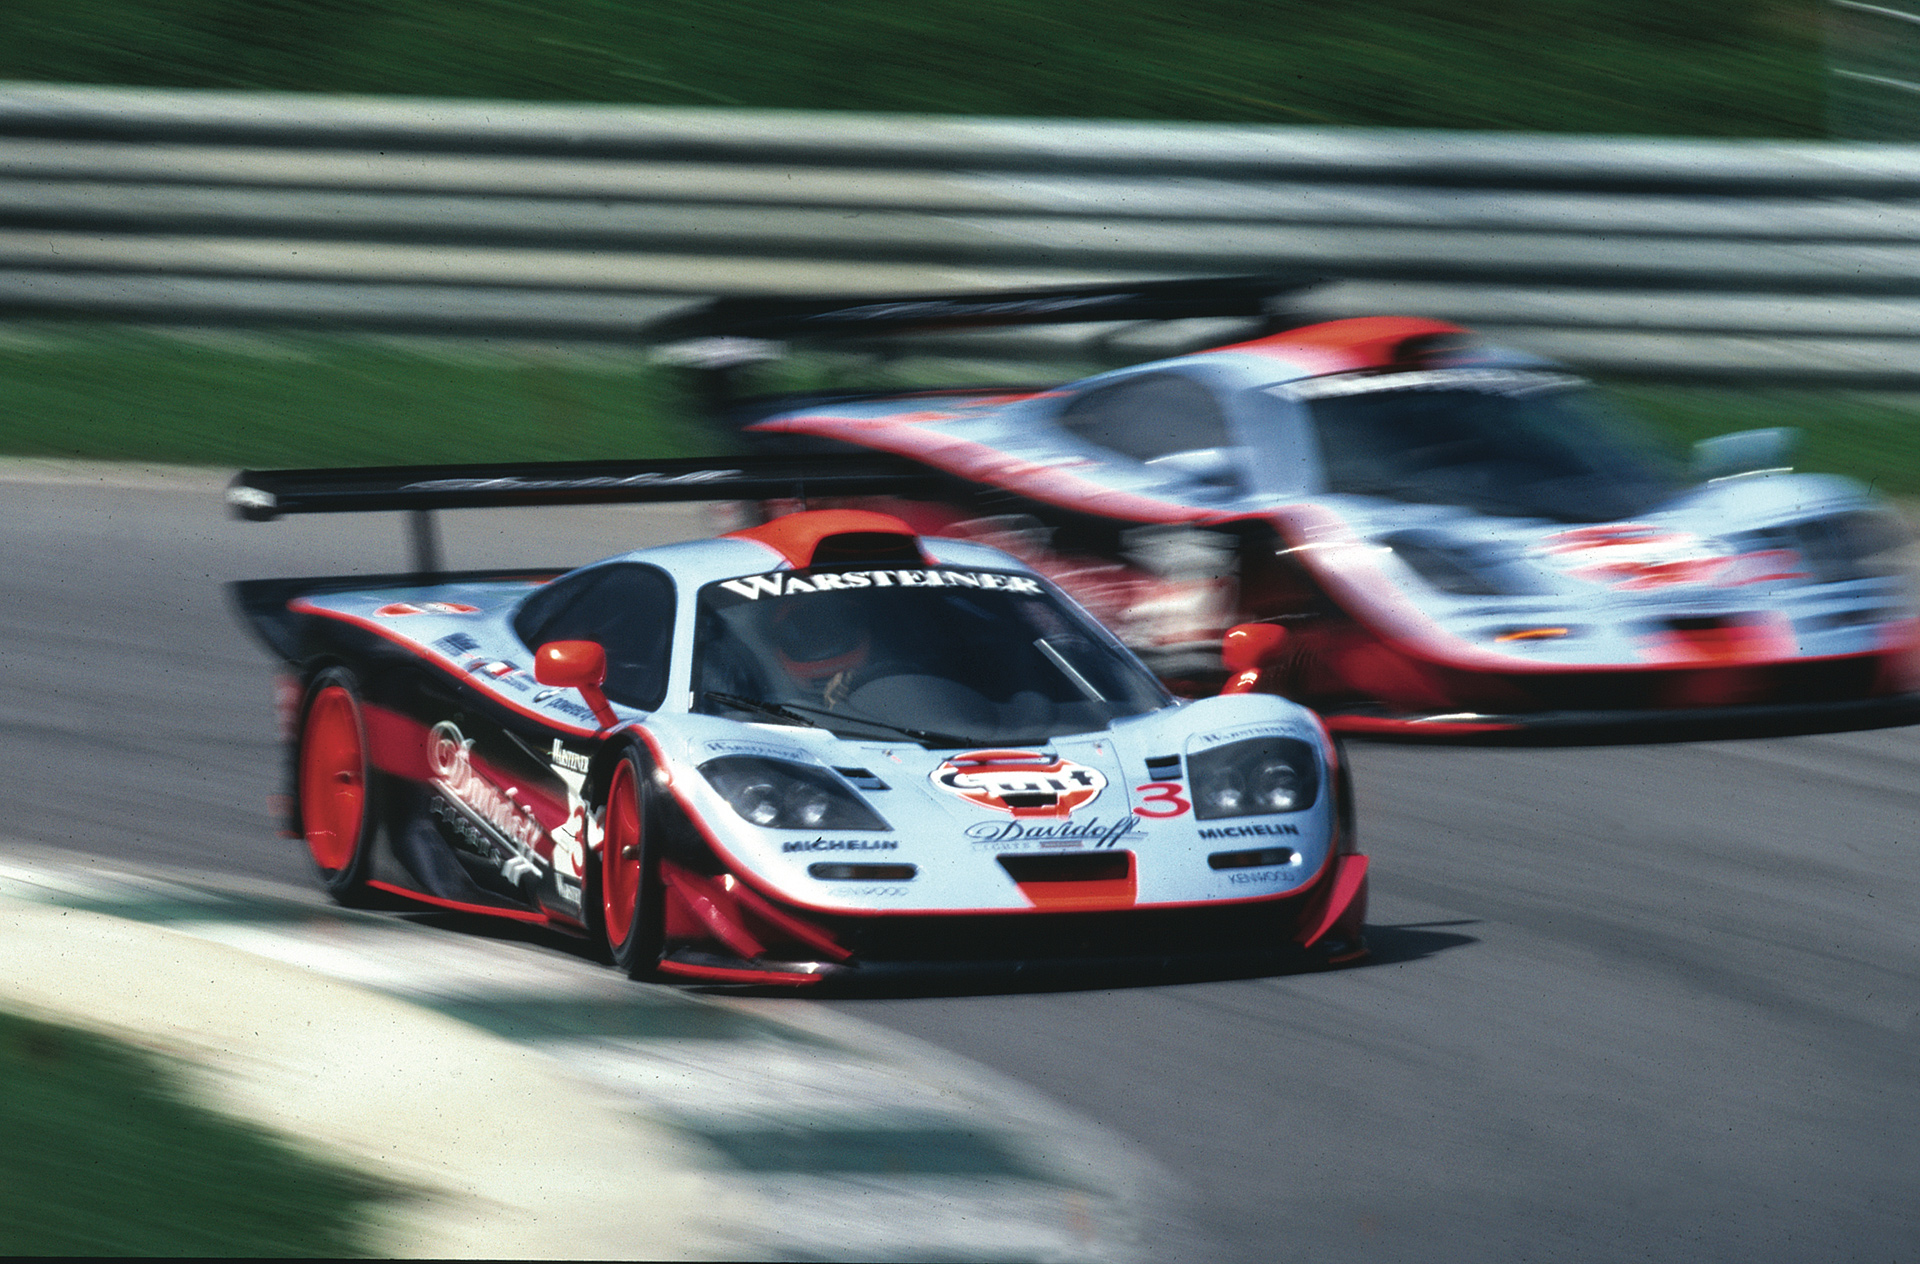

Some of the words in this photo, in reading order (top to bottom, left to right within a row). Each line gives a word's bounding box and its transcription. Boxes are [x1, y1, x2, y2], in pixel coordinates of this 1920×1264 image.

[720, 570, 1045, 600] WARSTEINER
[1133, 782, 1192, 819] 3
[964, 817, 1141, 849] Davidoff
[1198, 823, 1300, 839] MICHELIN
[782, 839, 899, 853] MICHELIN
[1228, 871, 1296, 885] KENWOOD
